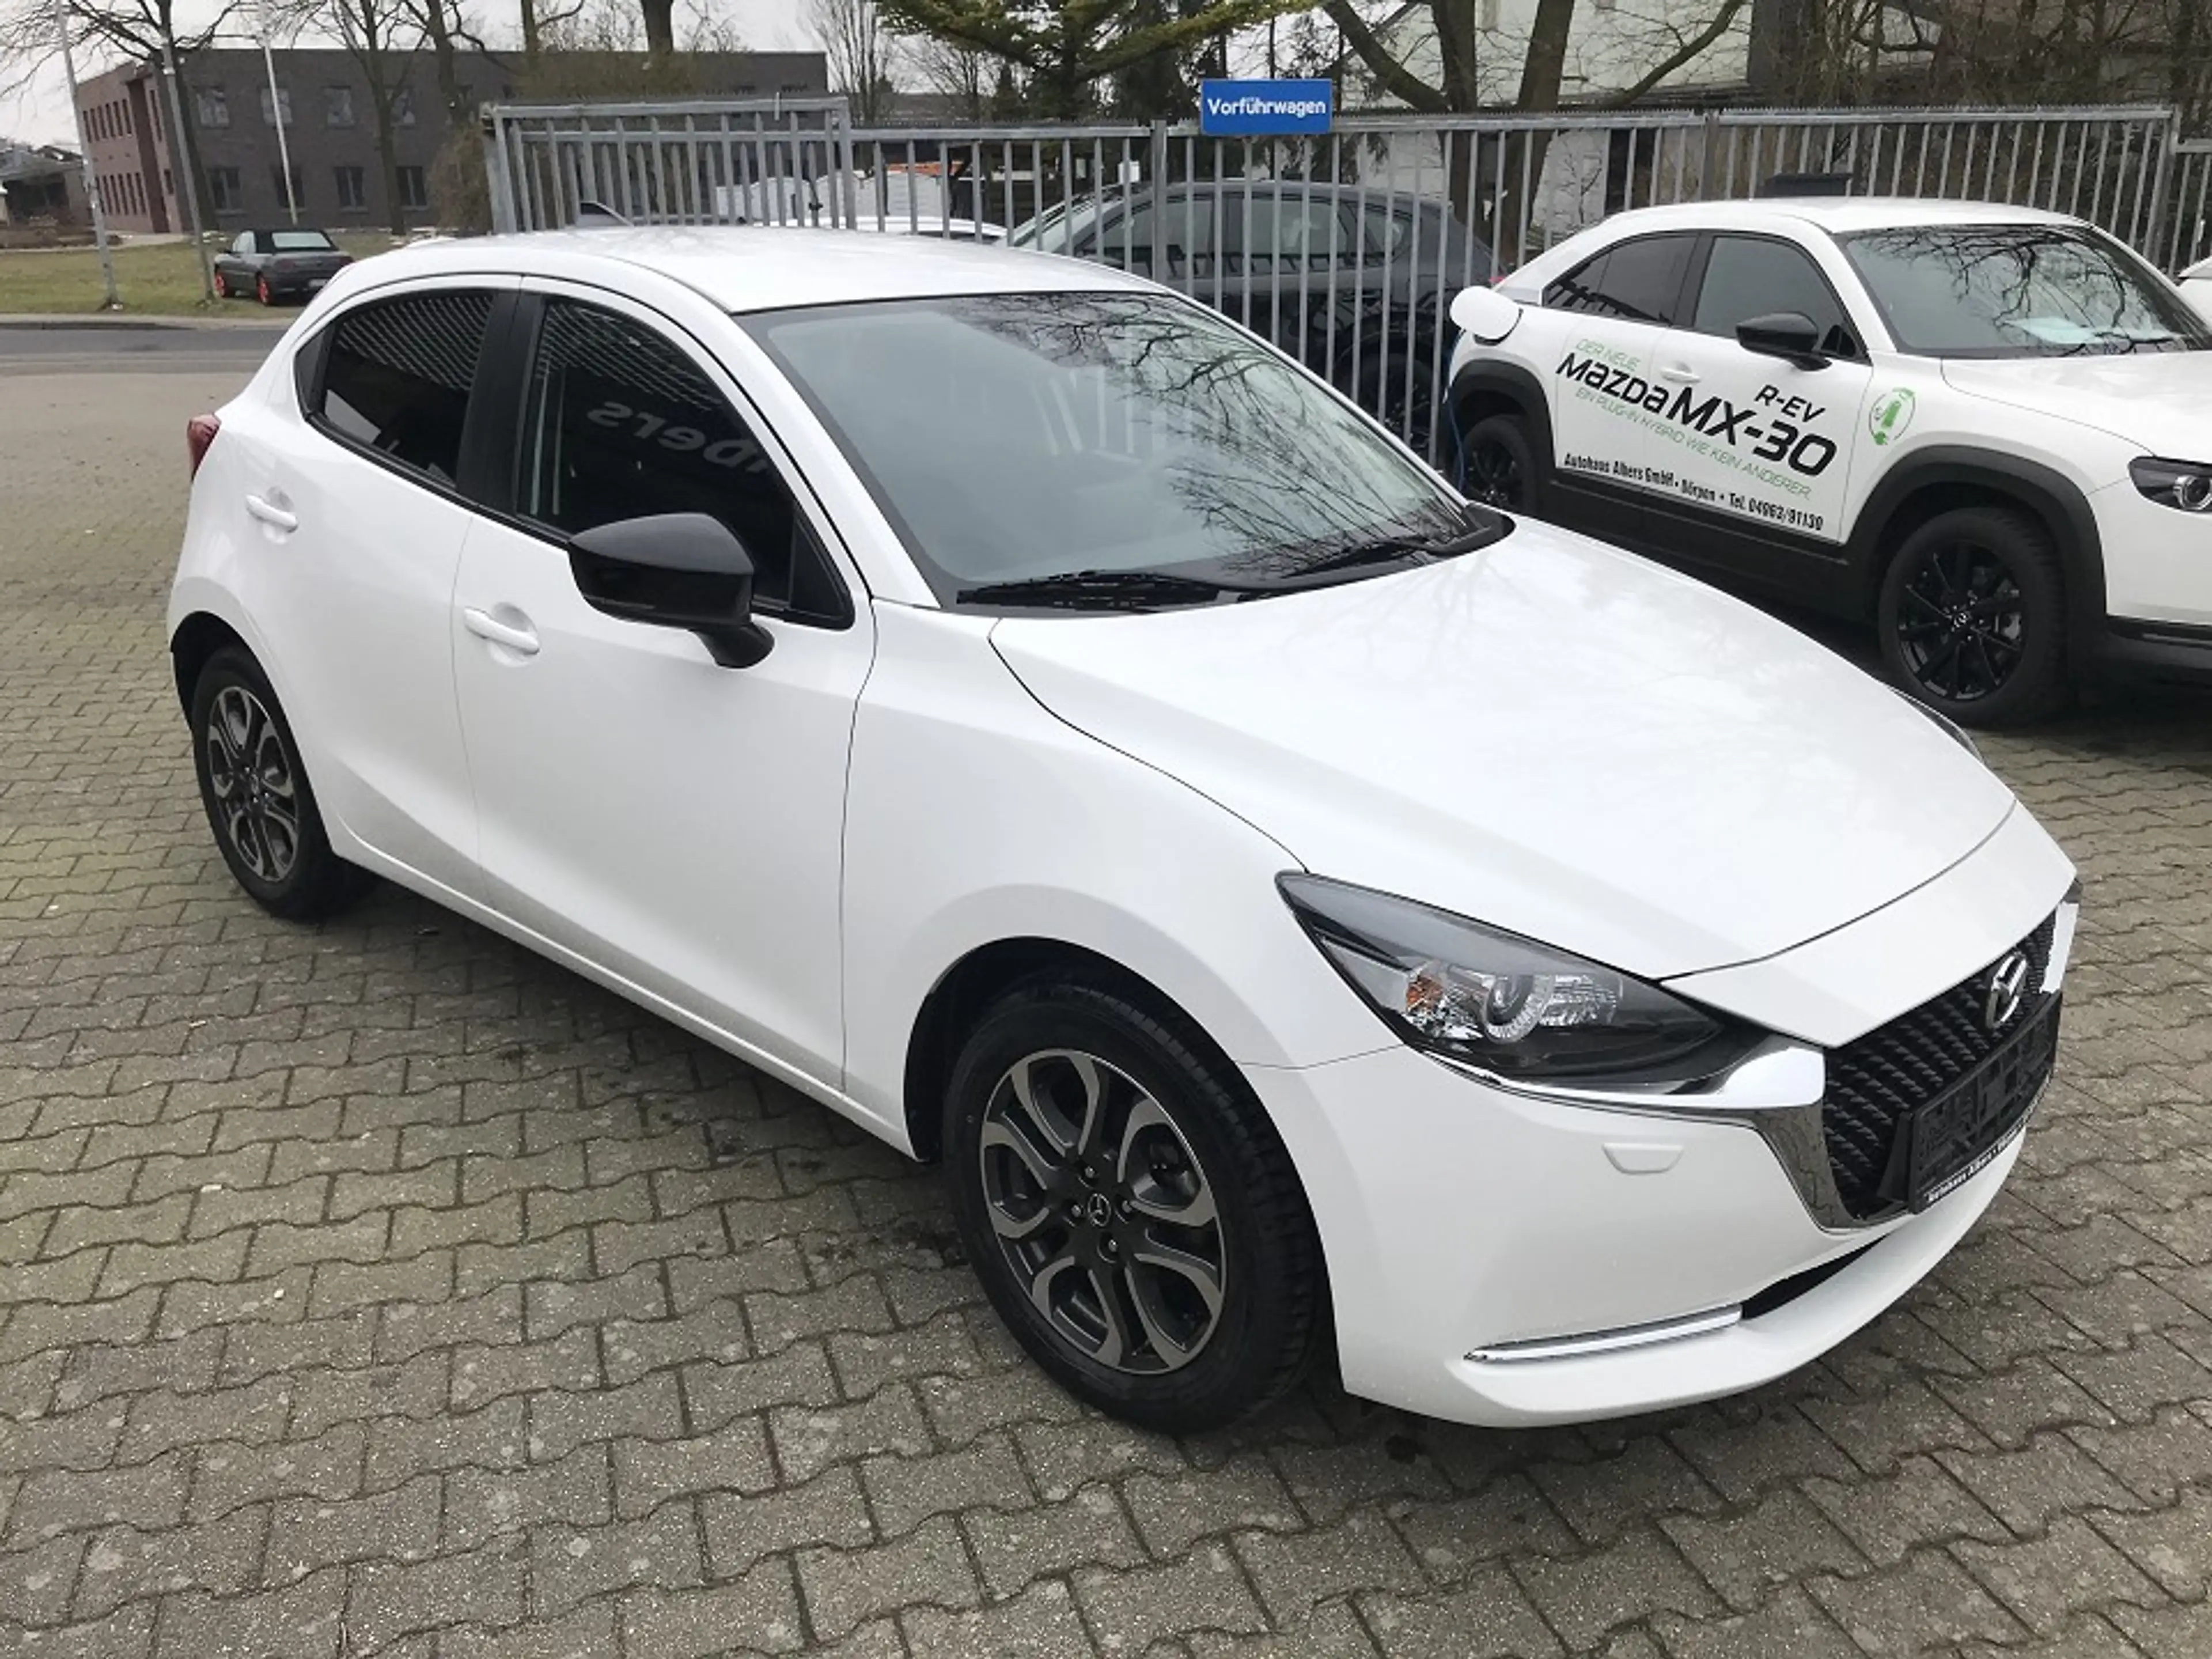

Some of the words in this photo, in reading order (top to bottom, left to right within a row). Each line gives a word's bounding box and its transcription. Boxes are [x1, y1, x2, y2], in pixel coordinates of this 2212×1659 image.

[1207, 96, 1326, 118] Vorführwagen
[1576, 339, 1604, 354] DER
[1604, 349, 1641, 372] NEUE
[1753, 384, 1826, 422] R-EV
[1596, 395, 1641, 422] PLUG-IN
[1641, 416, 1685, 444] HYBRID
[1686, 435, 1710, 455] WIE
[1710, 448, 1743, 469] KEIN
[1741, 462, 1812, 501] ANDERER
[1666, 387, 1838, 476] MX-30
[1564, 452, 1610, 473] Autohaus
[1613, 460, 1643, 480] Albers
[1645, 467, 1674, 487] GmbH
